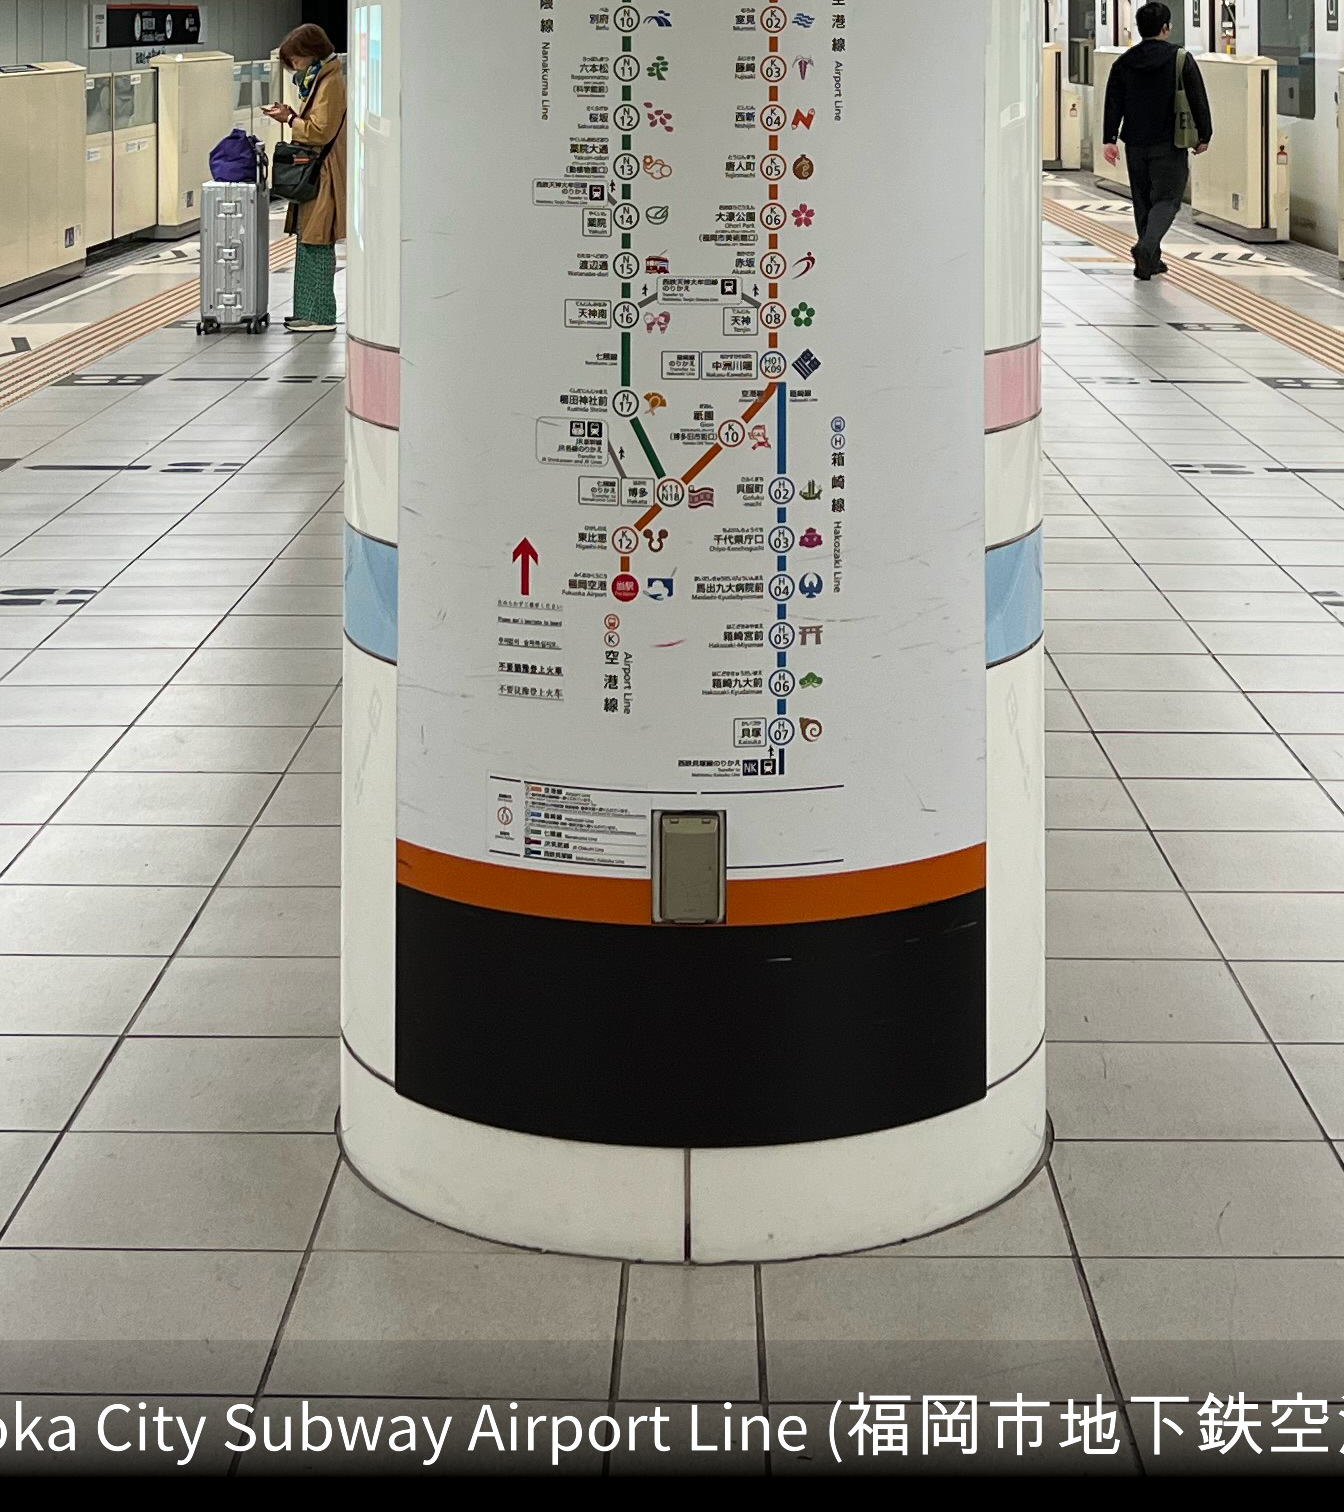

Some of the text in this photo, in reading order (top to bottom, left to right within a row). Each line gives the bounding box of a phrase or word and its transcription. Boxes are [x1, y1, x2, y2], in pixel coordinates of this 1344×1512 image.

[766, 18, 781, 29] 02
[580, 63, 609, 74] 六本松
[766, 67, 781, 78] 03
[542, 41, 551, 121] Nanakuma Line
[833, 60, 843, 122] Airport Line
[735, 111, 755, 122] 西新
[766, 116, 781, 127] 04
[765, 166, 780, 176] 05
[765, 215, 781, 225] 06
[735, 257, 755, 268] 赤坂
[765, 264, 780, 274] 07
[578, 308, 607, 319] 天神南
[765, 313, 781, 324] 08
[731, 315, 751, 326] 天神
[764, 357, 781, 365] H01
[764, 365, 782, 374] K09
[725, 431, 738, 442] 10
[831, 451, 845, 513] 箱崎線
[628, 487, 648, 498] 博多
[661, 484, 679, 493] K11
[774, 488, 789, 500] 02
[661, 493, 679, 501] N18
[618, 538, 632, 549] 12
[774, 537, 789, 548] 03
[833, 521, 842, 593] Hakozaki Line
[568, 579, 607, 591] 福岡空港
[774, 586, 789, 597] 04
[774, 635, 789, 645] 05
[604, 649, 619, 713] 空港線
[622, 651, 633, 714] Airport Line
[774, 682, 789, 692] 06
[774, 730, 789, 740] 07
